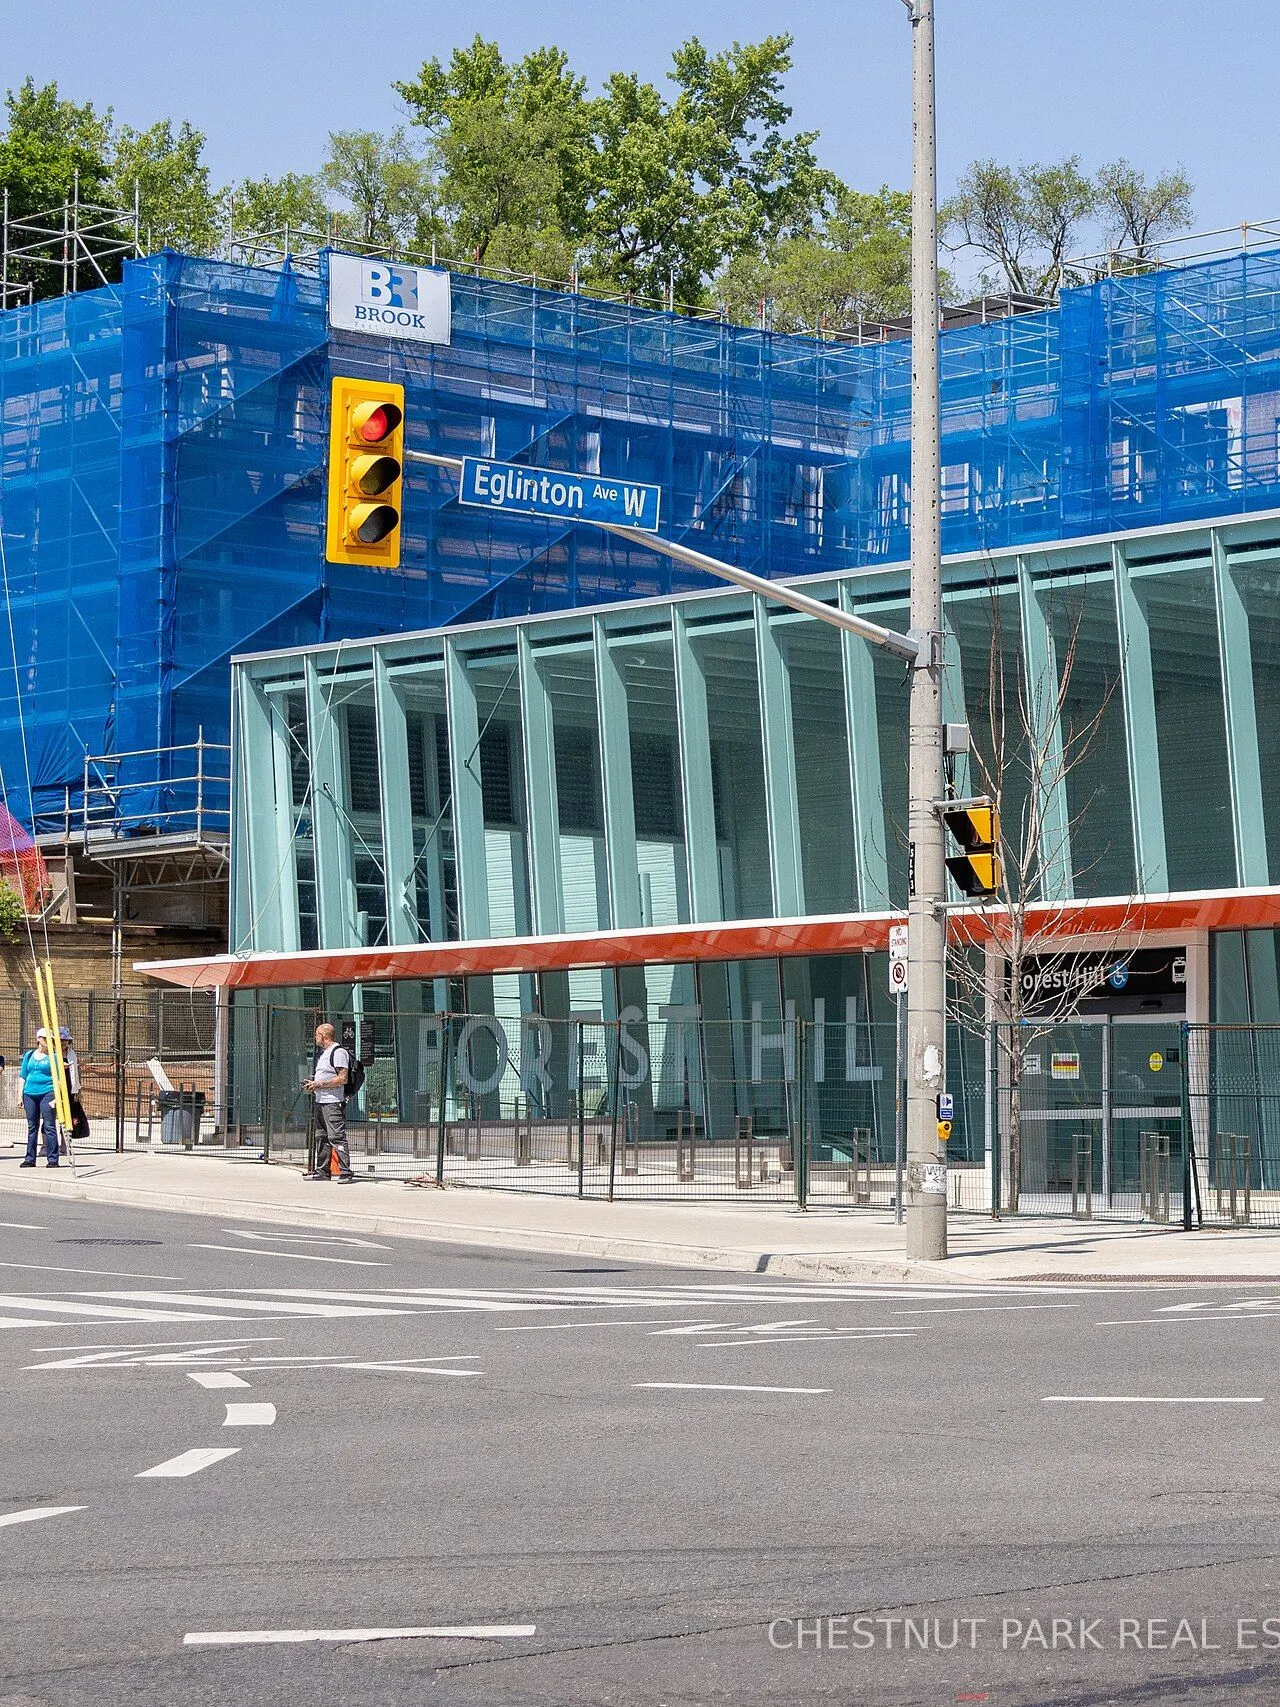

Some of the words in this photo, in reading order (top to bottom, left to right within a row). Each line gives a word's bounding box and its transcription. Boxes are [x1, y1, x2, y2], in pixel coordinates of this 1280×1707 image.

[354, 305, 426, 330] BROOK
[474, 464, 584, 509] Eglinton
[593, 484, 618, 501] Ave
[624, 487, 647, 518] W
[1019, 968, 1072, 990] orest
[417, 1003, 702, 1096] FOREST
[751, 996, 908, 1084] HIL
